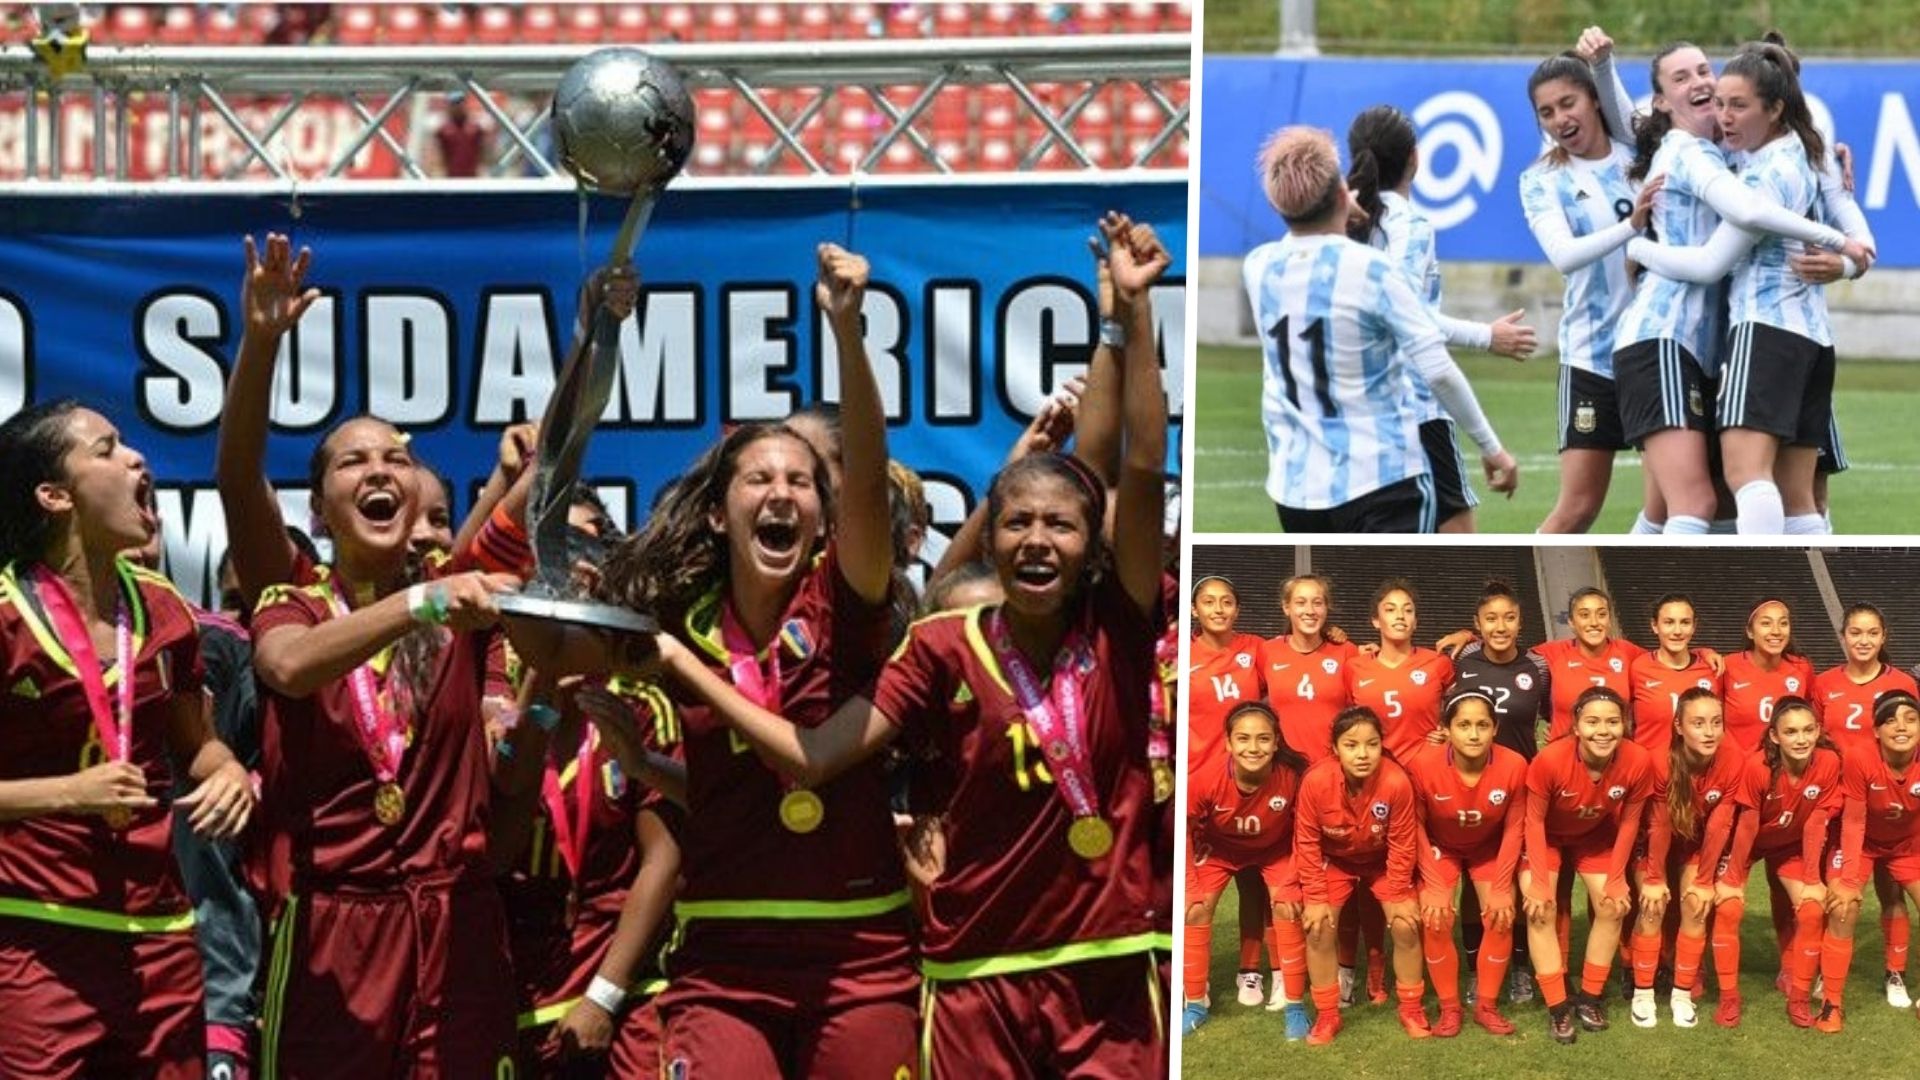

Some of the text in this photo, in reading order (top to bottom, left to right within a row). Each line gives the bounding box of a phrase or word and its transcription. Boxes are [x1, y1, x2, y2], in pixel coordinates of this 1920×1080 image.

[1266, 315, 1339, 419] 11
[1211, 673, 1241, 702] 14
[1296, 674, 1315, 701] 4
[1384, 690, 1403, 718] 5
[1759, 696, 1774, 723] 6
[1845, 703, 1863, 730] 2
[1233, 814, 1261, 836] 10
[1456, 810, 1482, 828] 13
[1884, 802, 1904, 822] 3
